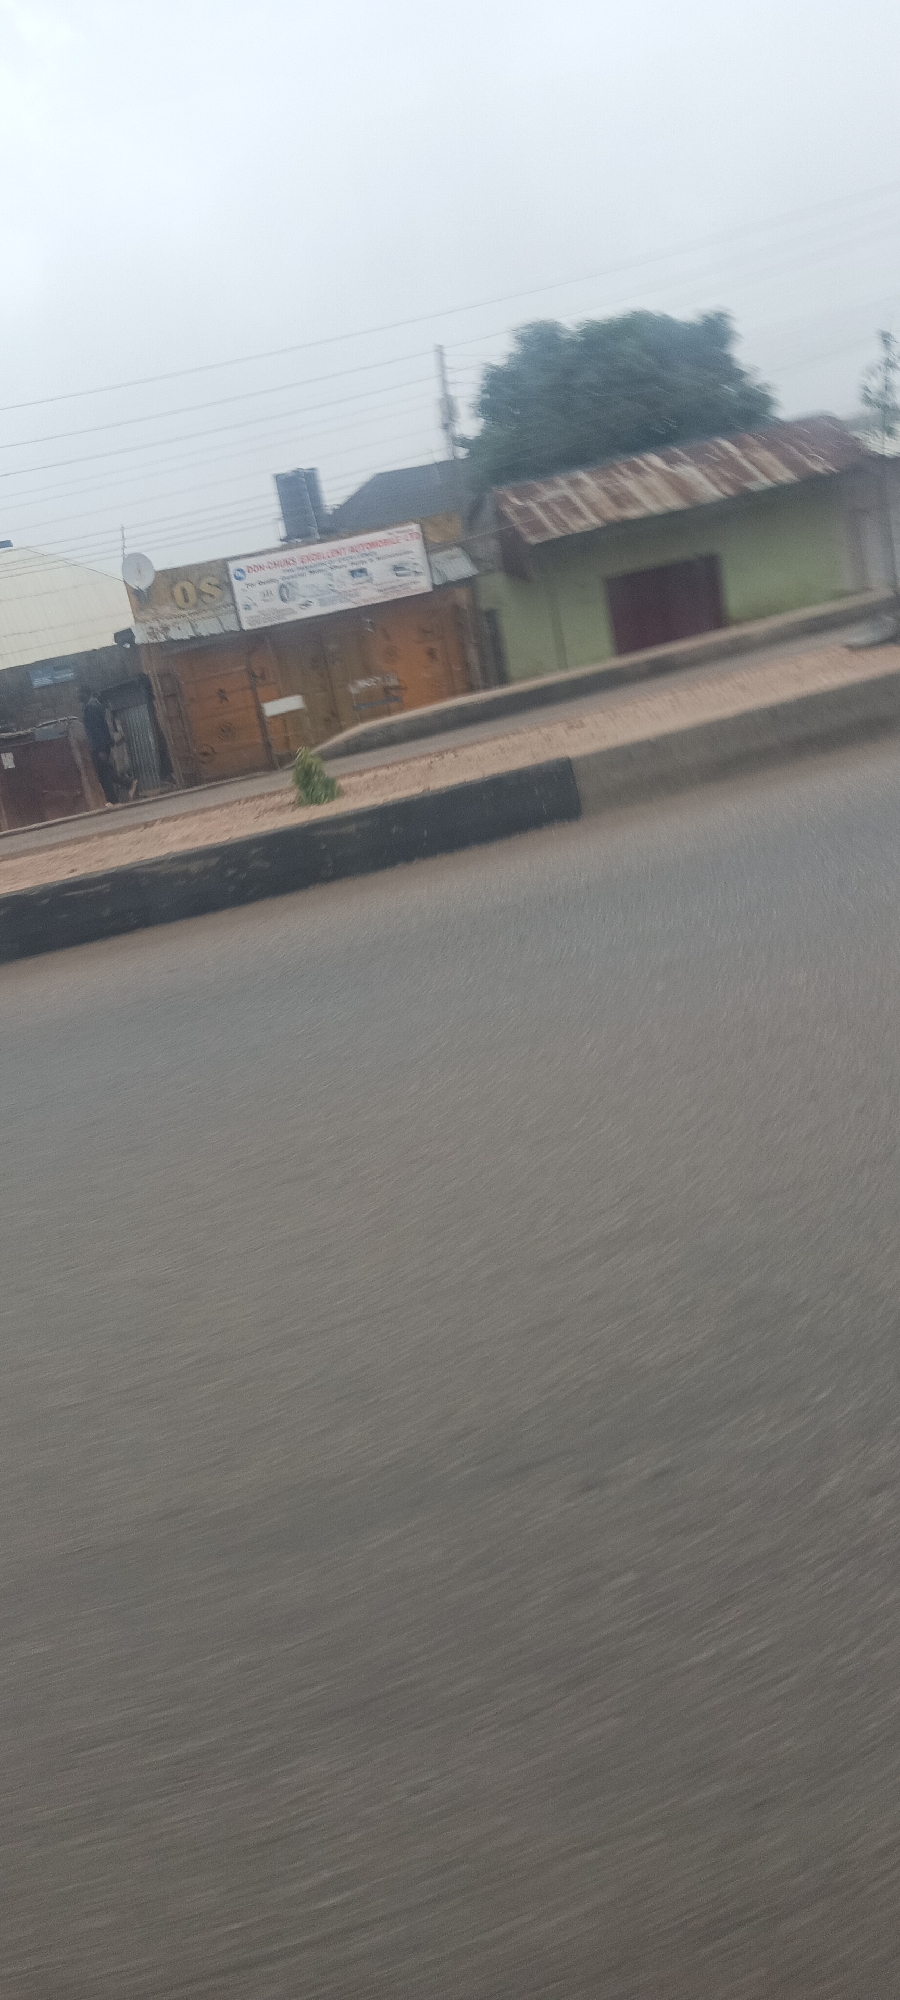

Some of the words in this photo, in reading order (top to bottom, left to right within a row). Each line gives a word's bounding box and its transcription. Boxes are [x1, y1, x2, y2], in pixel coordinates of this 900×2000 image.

[247, 558, 297, 573] DON-CHUKS
[300, 547, 348, 563] EXCELLENT
[349, 538, 402, 552] AUTOMOBILE
[405, 531, 421, 541] LTD
